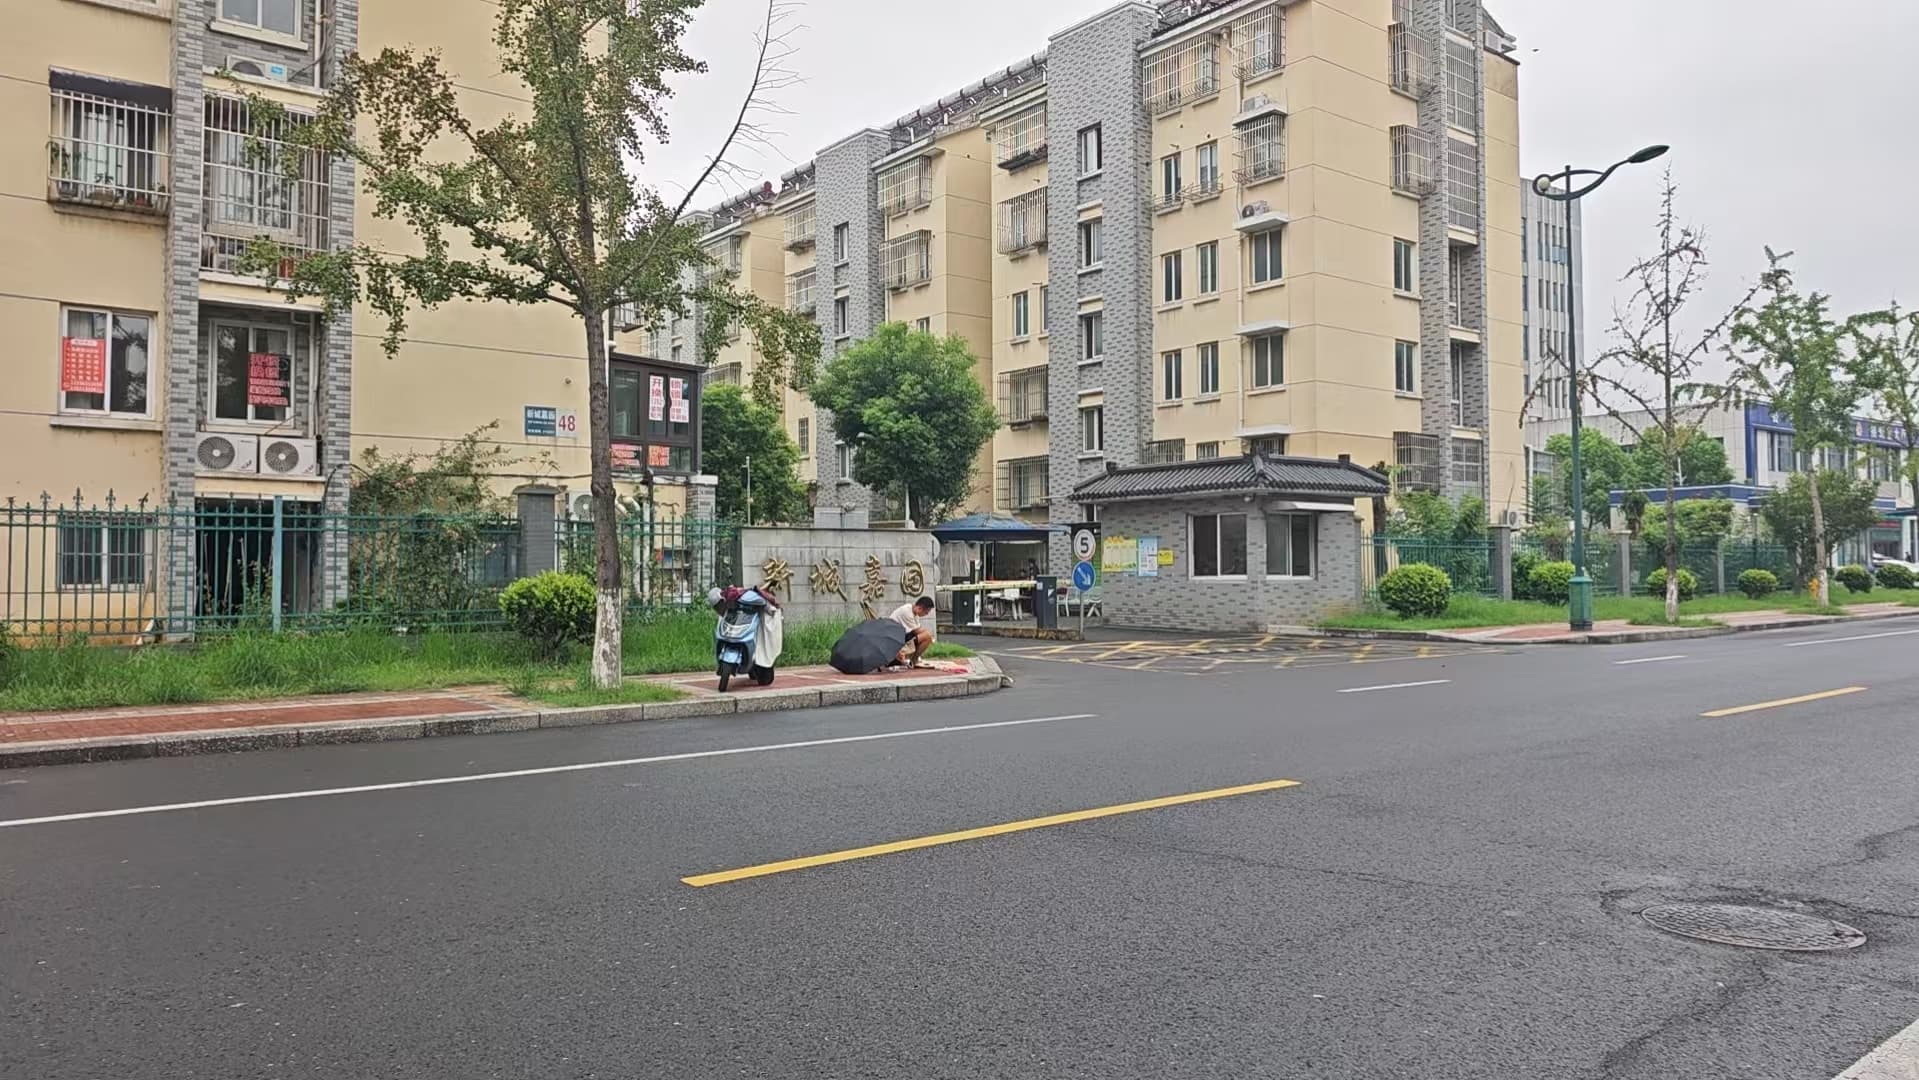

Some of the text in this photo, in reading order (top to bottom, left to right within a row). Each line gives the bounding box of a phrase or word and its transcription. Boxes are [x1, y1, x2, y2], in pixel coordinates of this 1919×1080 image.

[559, 415, 576, 432] 48
[1080, 537, 1089, 554] 5
[760, 554, 925, 602] 新城嘉园
